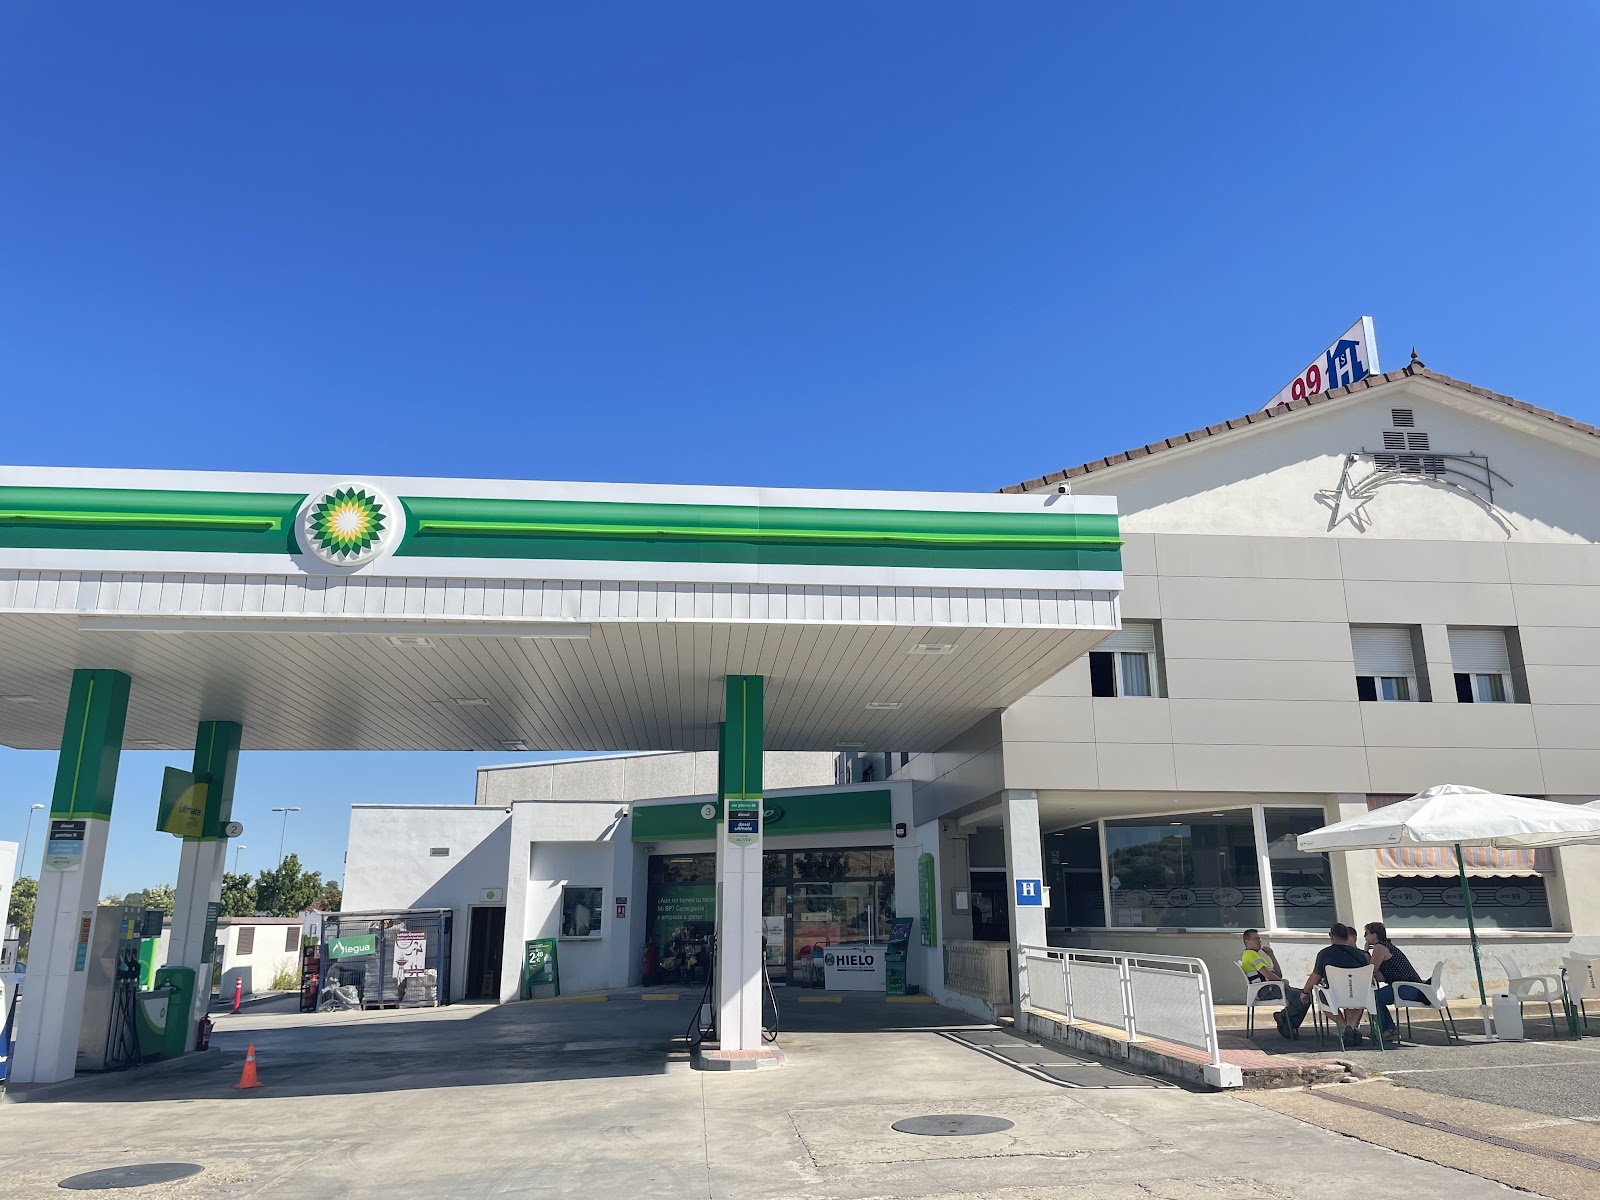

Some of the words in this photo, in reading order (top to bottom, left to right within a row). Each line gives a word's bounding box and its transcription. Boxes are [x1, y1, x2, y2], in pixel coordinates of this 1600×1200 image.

[705, 808, 712, 816] 3
[231, 825, 238, 834] 2
[1021, 882, 1036, 896] H
[836, 955, 874, 966] HIELO
